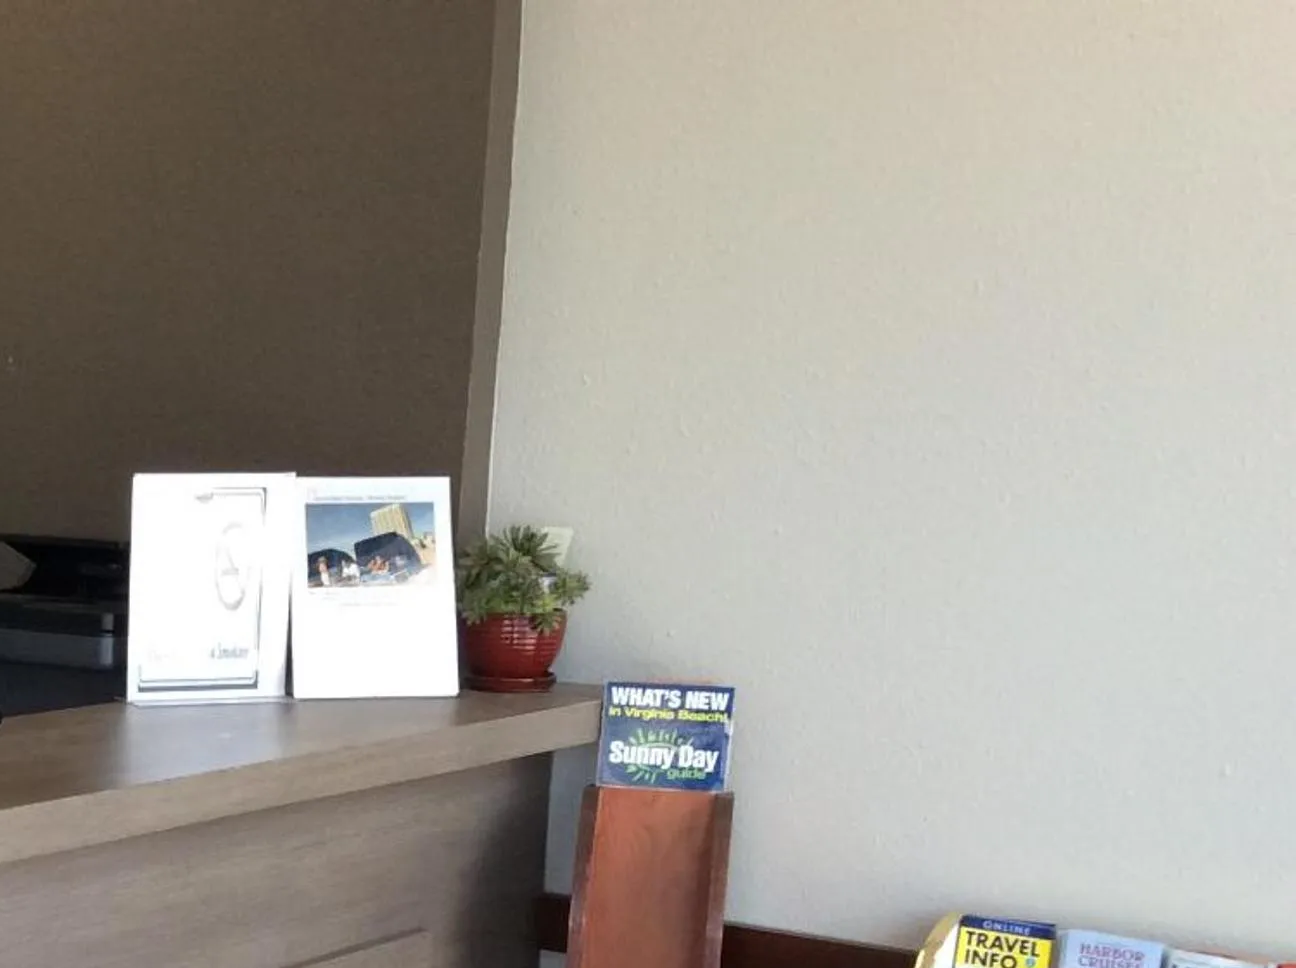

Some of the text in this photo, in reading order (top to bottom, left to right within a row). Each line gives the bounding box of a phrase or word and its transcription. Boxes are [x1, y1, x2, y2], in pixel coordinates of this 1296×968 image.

[611, 686, 730, 711] WHAT'S NEW
[609, 706, 621, 717] in
[624, 707, 675, 721] Virginia
[609, 741, 719, 772] Sunny Day
[667, 767, 706, 780] guide
[983, 920, 1031, 936] ONLINE
[965, 930, 1040, 957] TRAVEL
[1079, 943, 1145, 961] HARBOR
